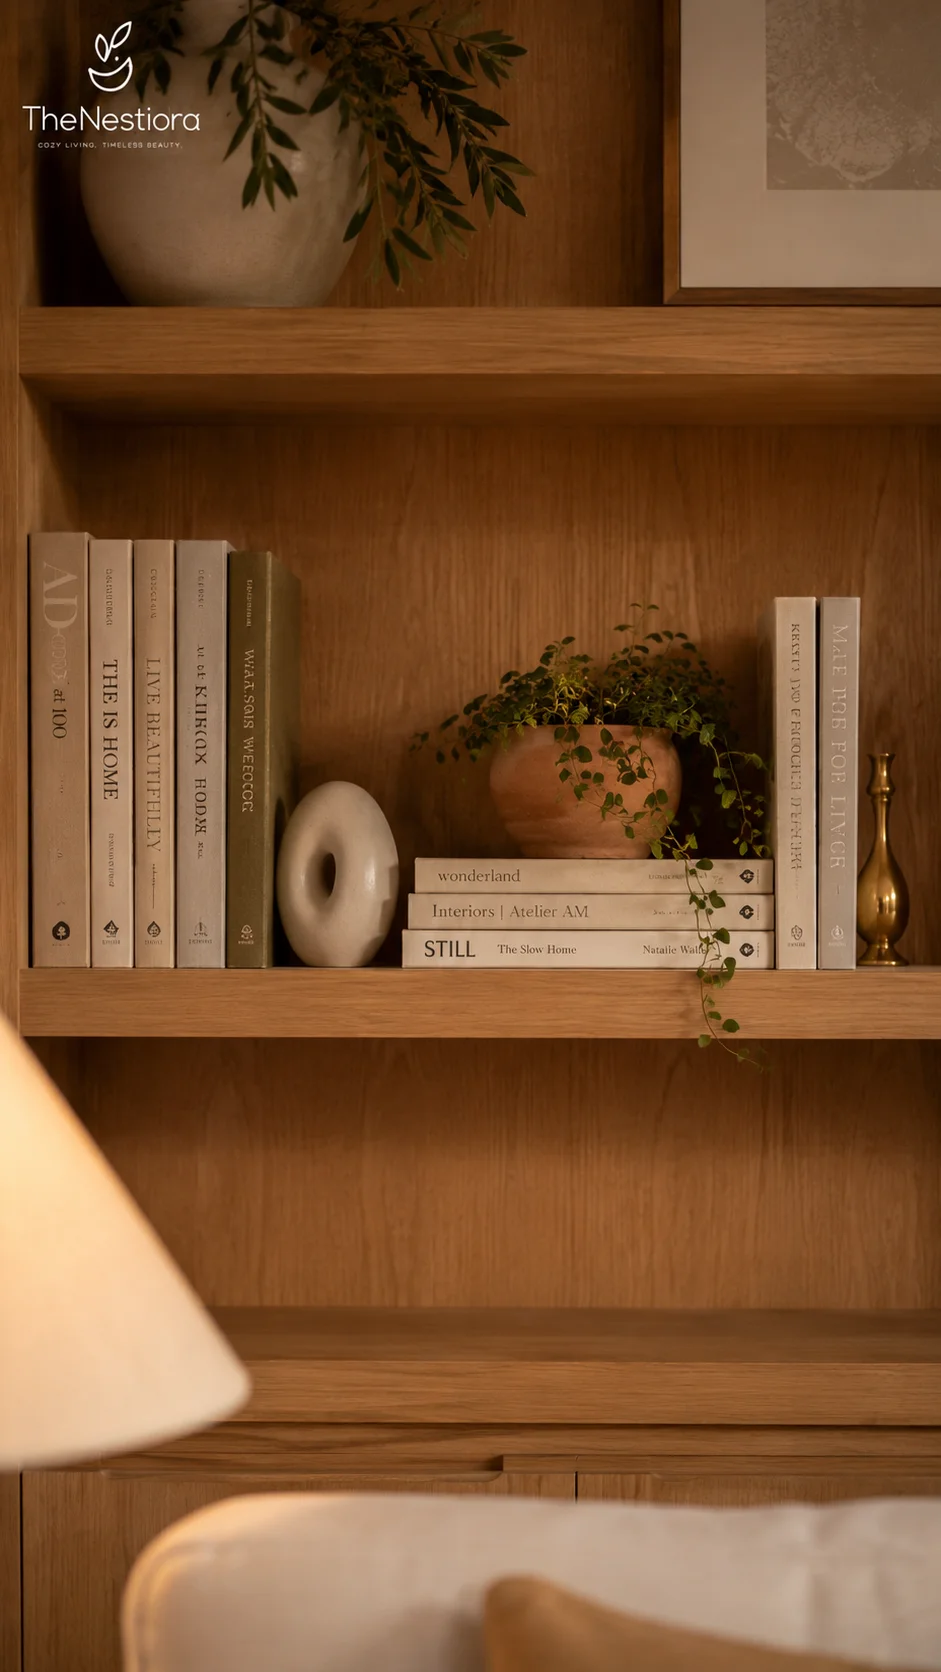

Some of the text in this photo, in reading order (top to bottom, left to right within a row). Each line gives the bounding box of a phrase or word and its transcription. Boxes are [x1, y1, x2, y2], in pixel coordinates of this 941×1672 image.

[42, 560, 79, 629] AD
[146, 658, 161, 705] LIVE
[53, 688, 65, 703] at
[52, 707, 68, 739] 100
[102, 659, 118, 800] THE IS HOME
[438, 868, 521, 883] wonderland
[432, 904, 495, 918] Interiors
[509, 904, 558, 918] Atelier
[562, 904, 589, 918] AM
[424, 940, 476, 958] STILL
[497, 944, 577, 955] The Slow Home
